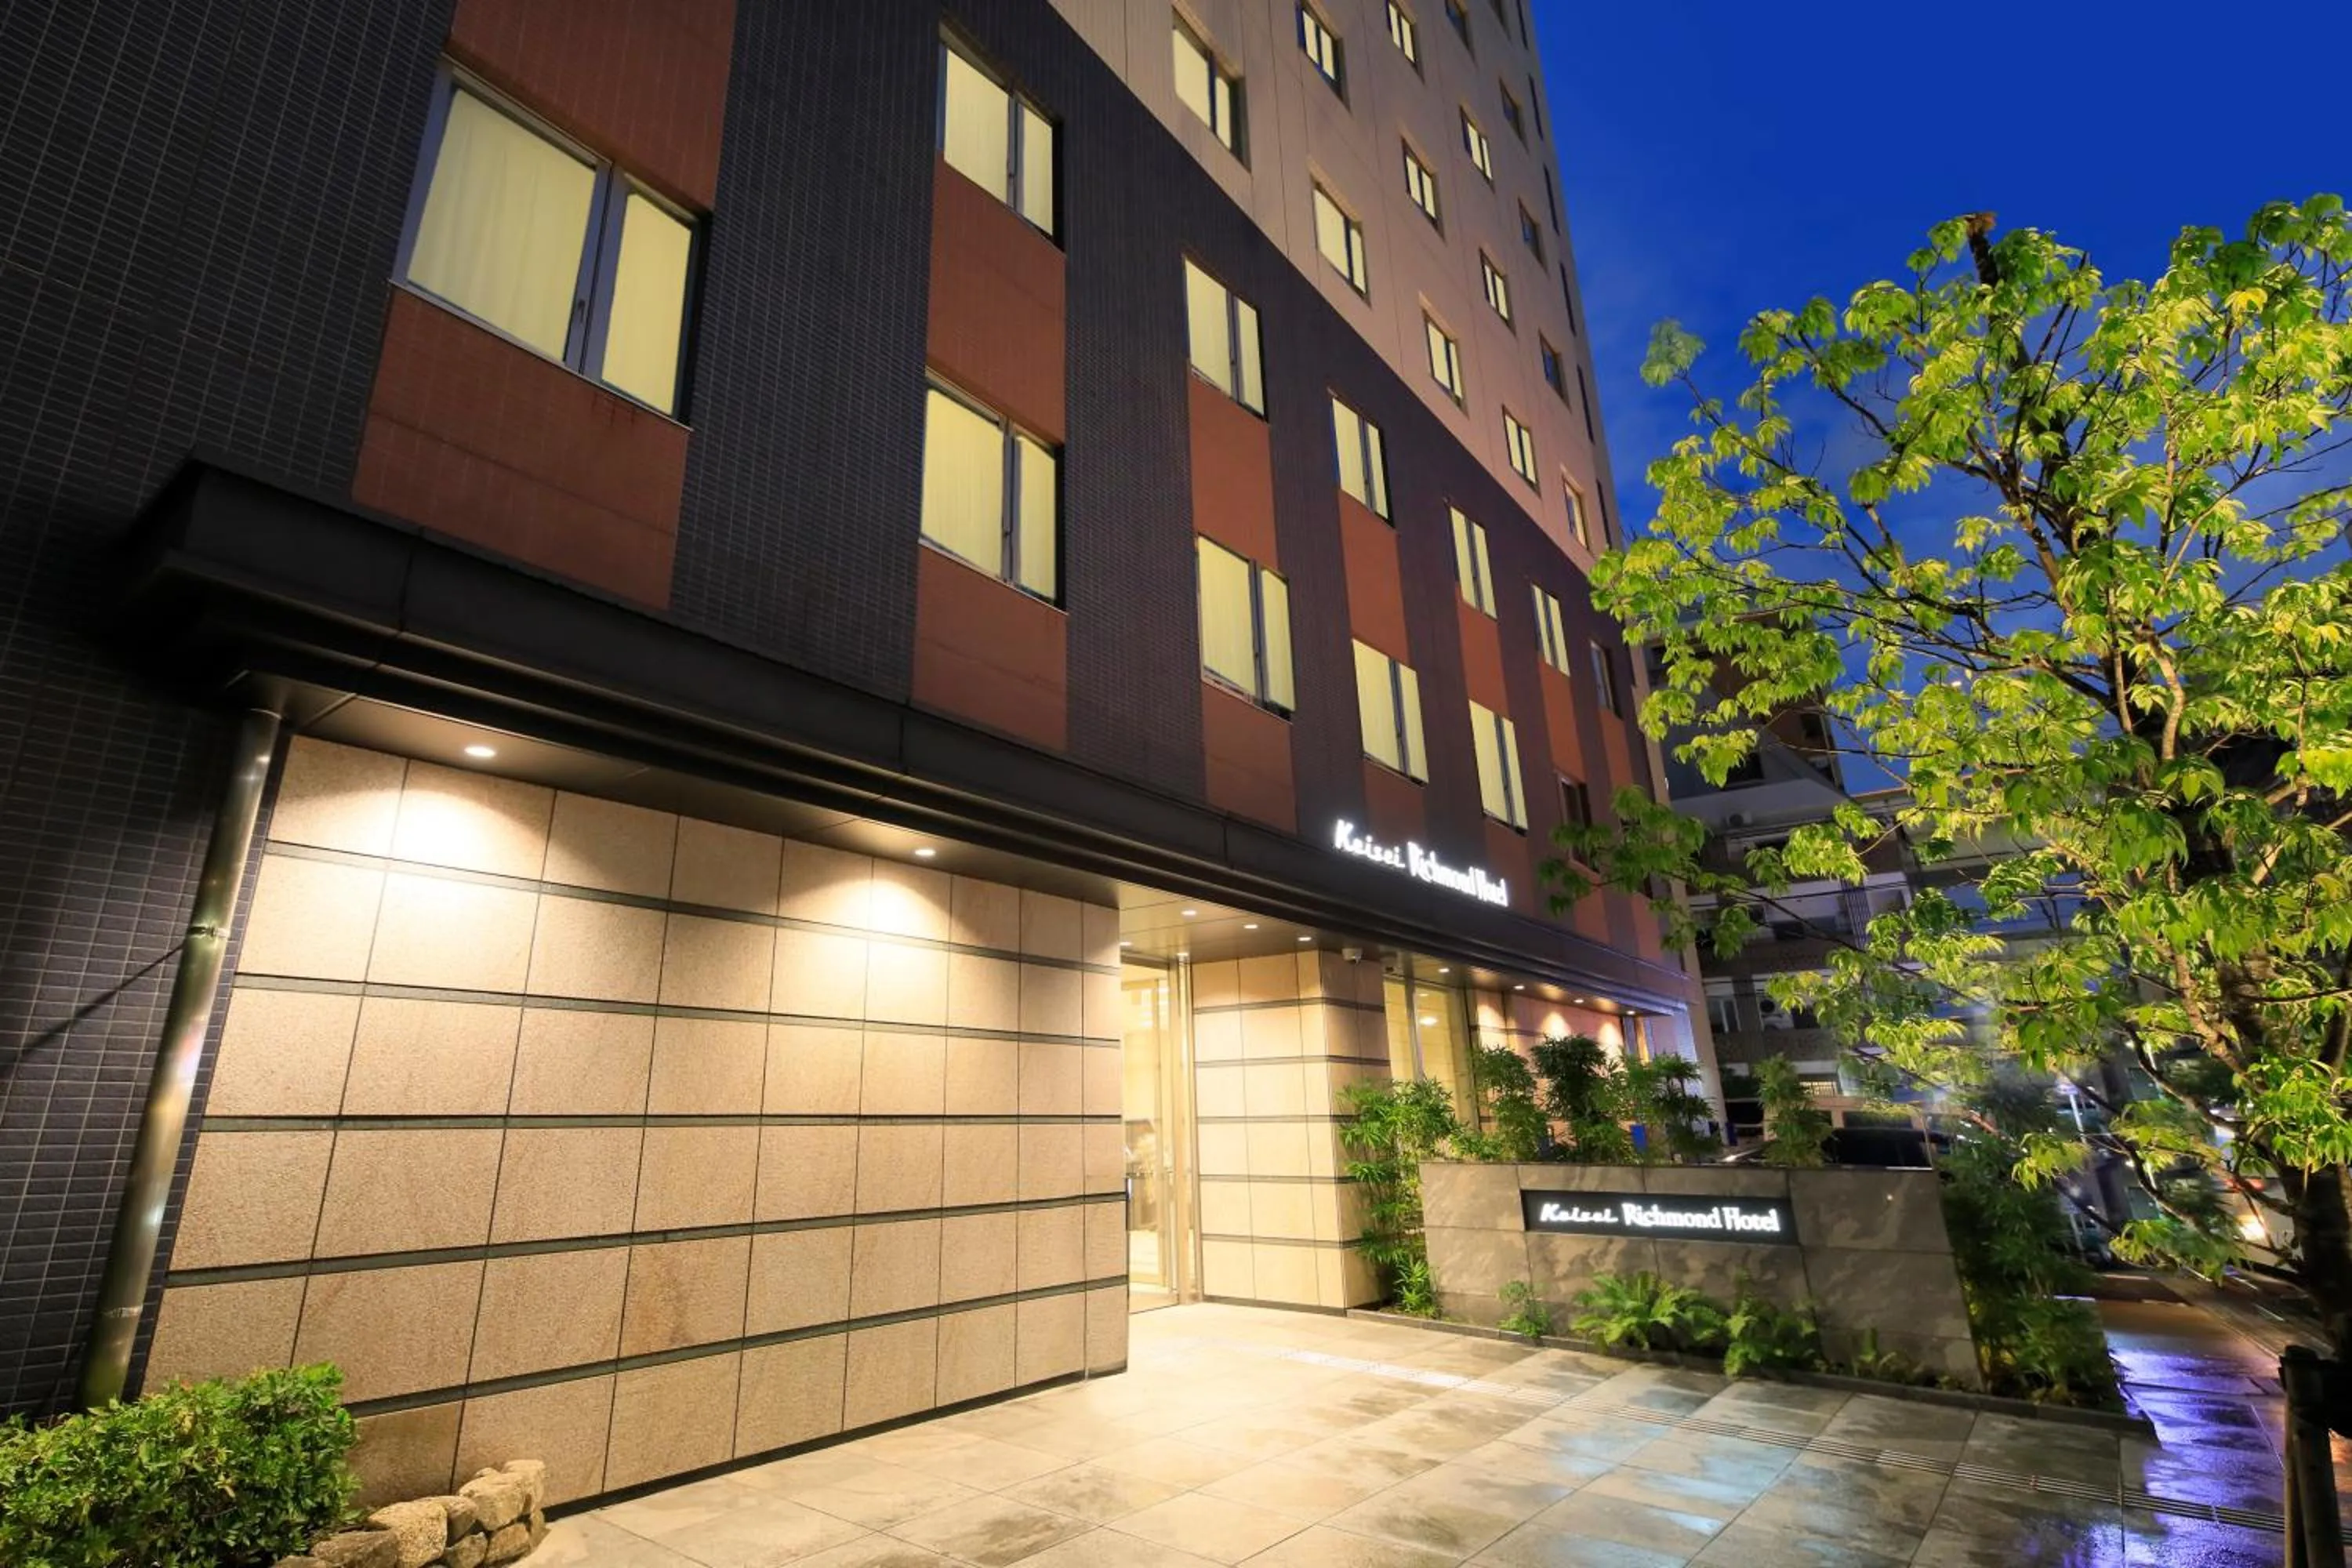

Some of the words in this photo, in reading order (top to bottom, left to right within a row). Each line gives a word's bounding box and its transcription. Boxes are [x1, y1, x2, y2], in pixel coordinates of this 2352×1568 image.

[1334, 818, 1406, 868] Keisei
[1407, 840, 1475, 896] Richmond
[1540, 1203, 1618, 1223] Keisei
[1621, 1203, 1722, 1229] Richmond
[1722, 1206, 1780, 1232] Hotel
